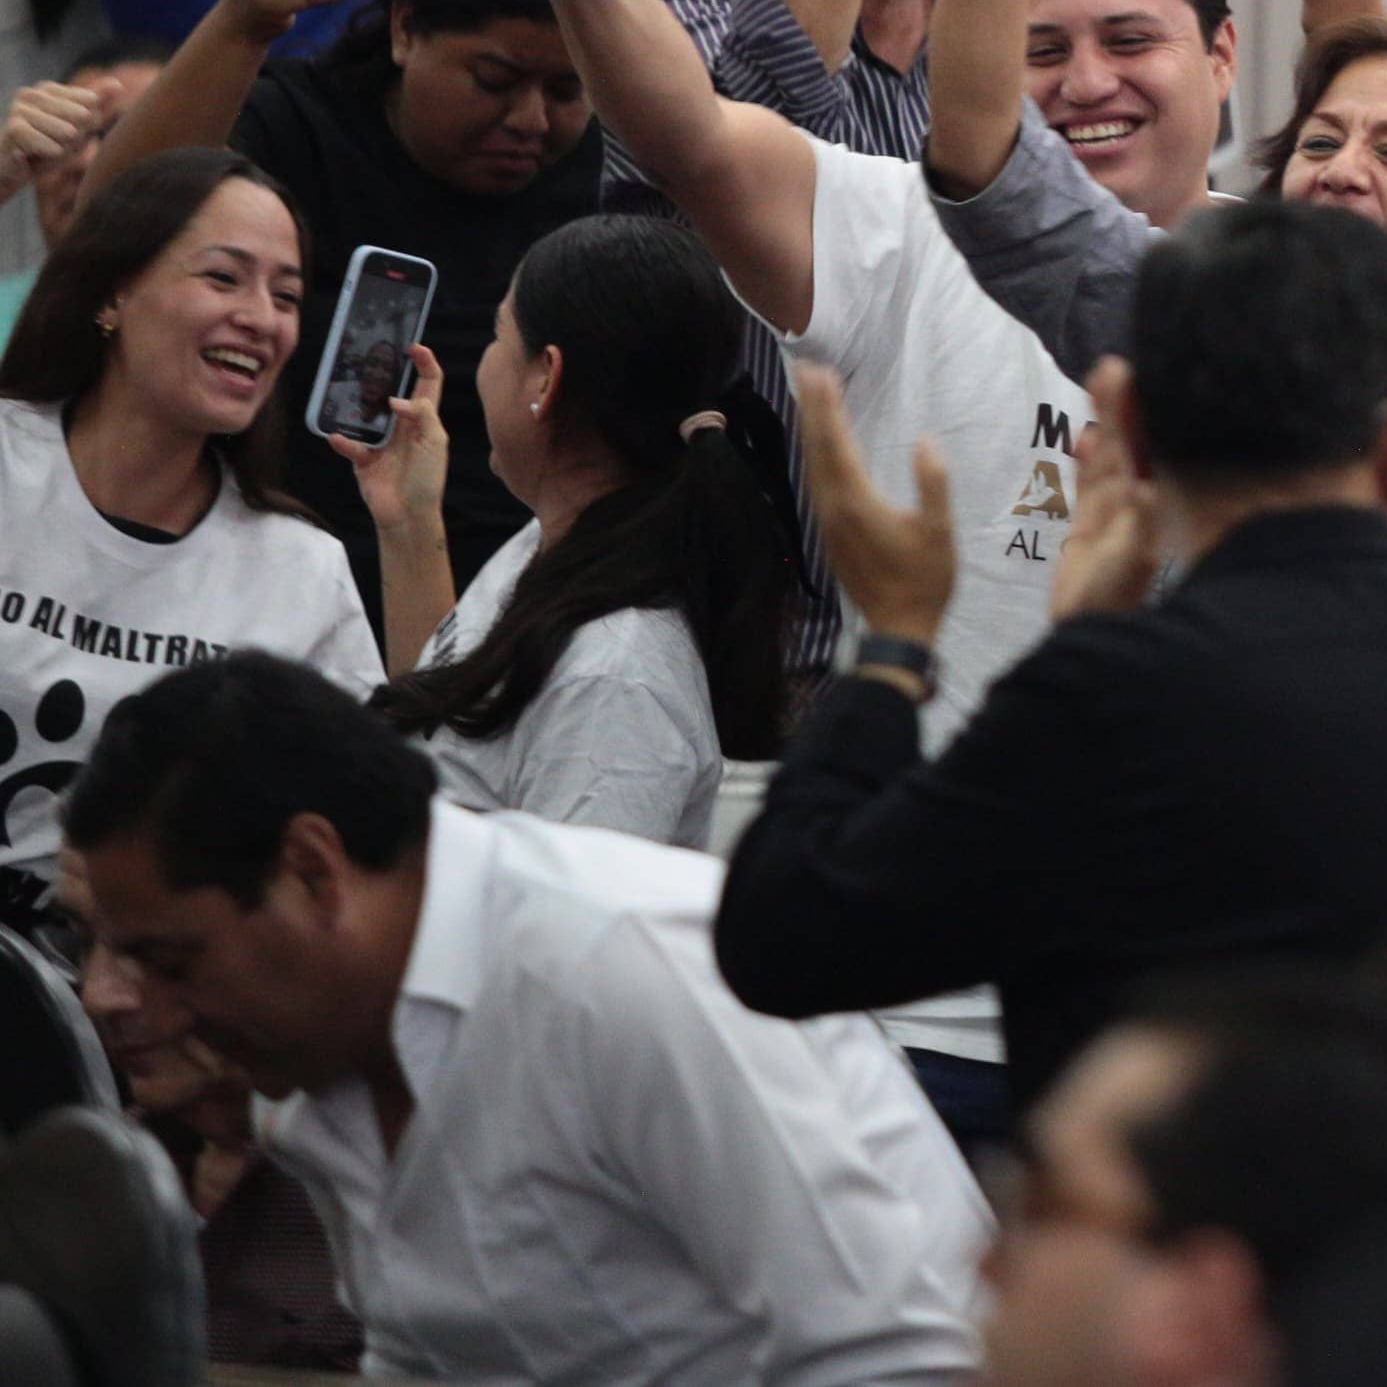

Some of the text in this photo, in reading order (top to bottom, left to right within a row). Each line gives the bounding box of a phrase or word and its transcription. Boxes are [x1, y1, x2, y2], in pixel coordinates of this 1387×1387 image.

[1005, 528, 1047, 561] AL
[0, 588, 228, 666] O AL MALTRAT
